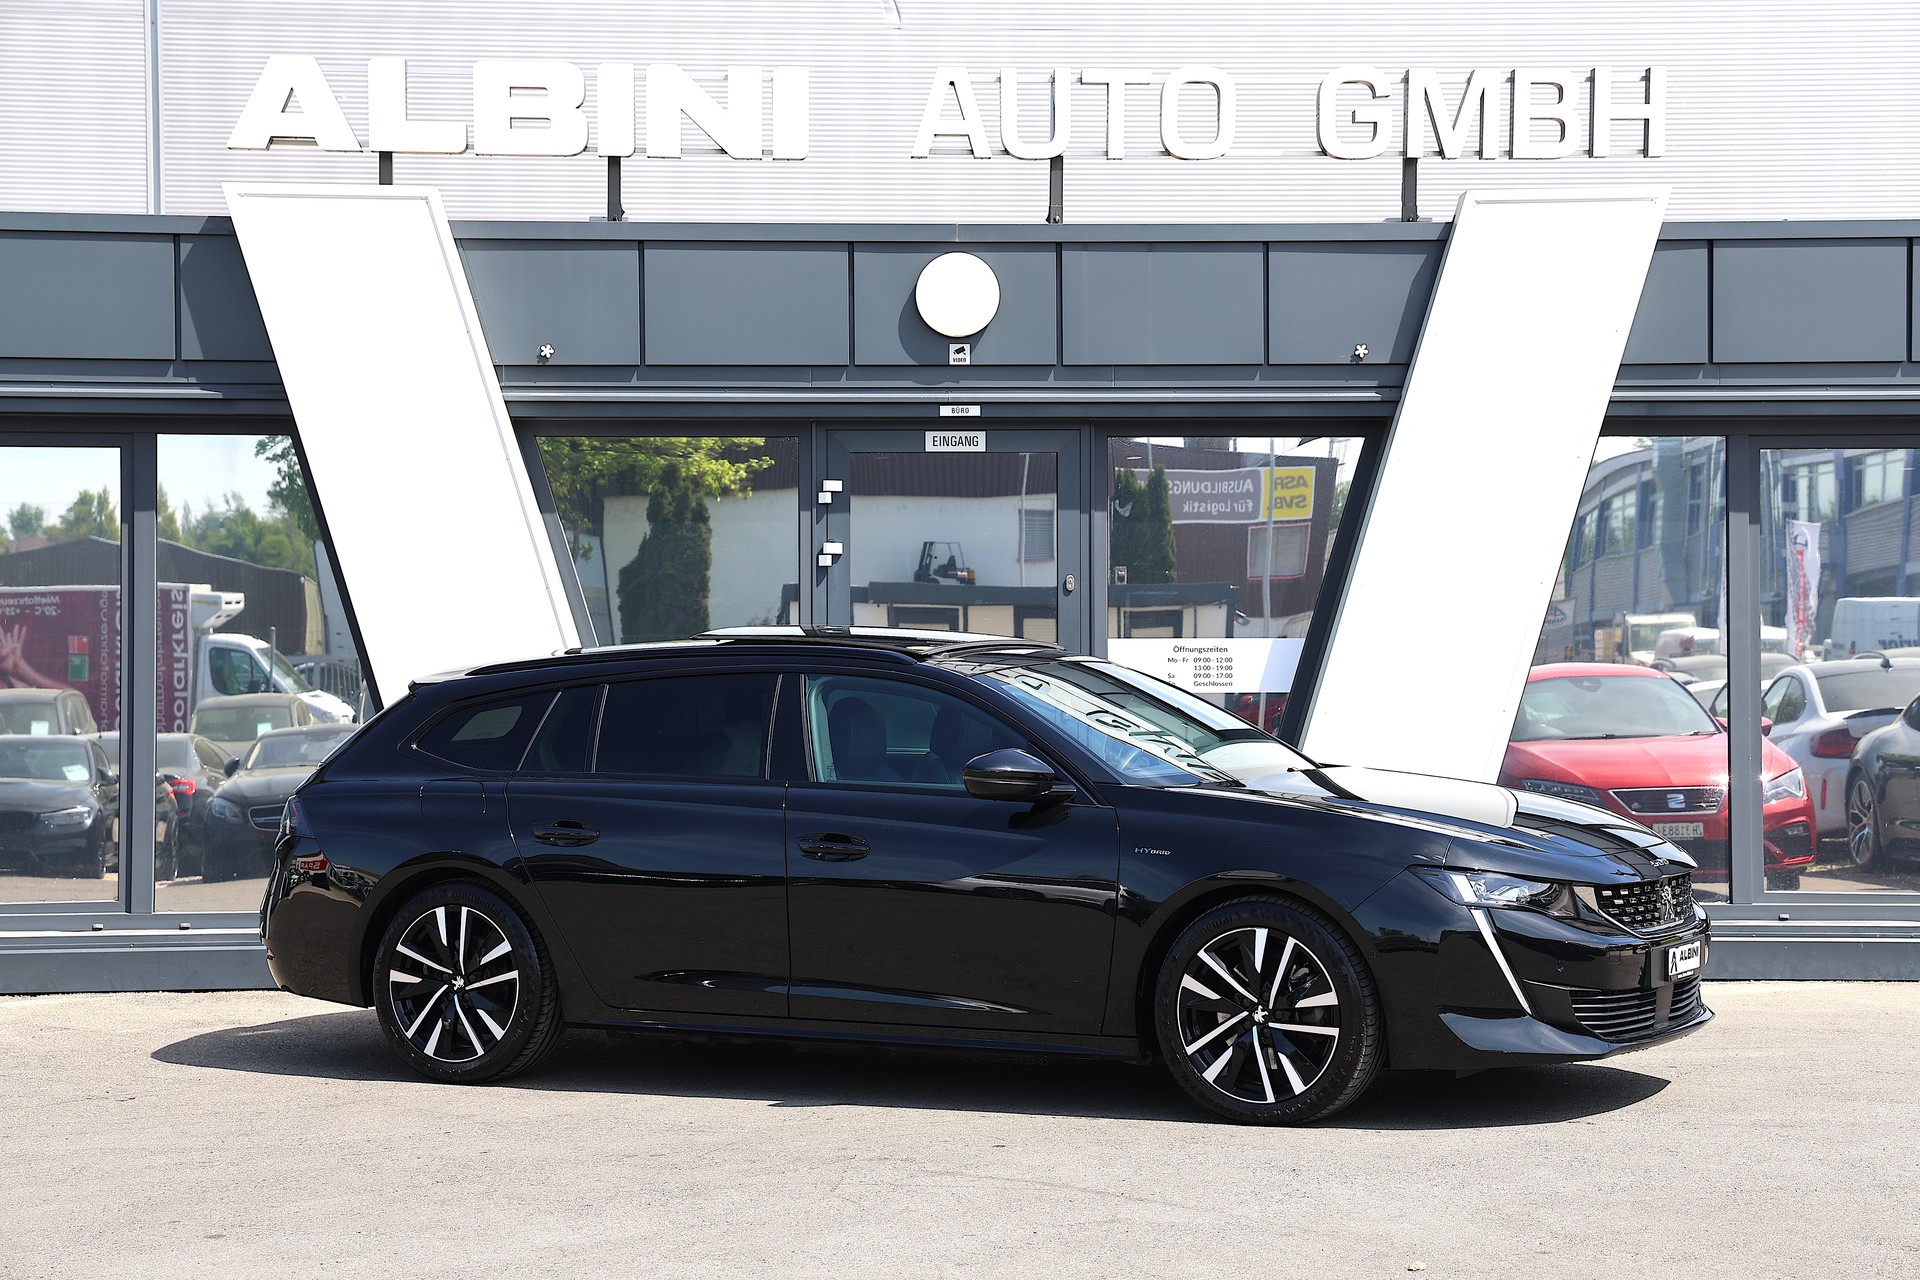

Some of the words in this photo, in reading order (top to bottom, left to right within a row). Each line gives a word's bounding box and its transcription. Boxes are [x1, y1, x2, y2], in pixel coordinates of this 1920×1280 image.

[226, 55, 810, 161] ALBINI
[911, 66, 1237, 160] AUTO
[1316, 65, 1667, 160] GMBH
[932, 435, 979, 447] EINGANG
[1173, 645, 1228, 654] Öffnungszeiten
[1679, 945, 1699, 962] ALBINI
